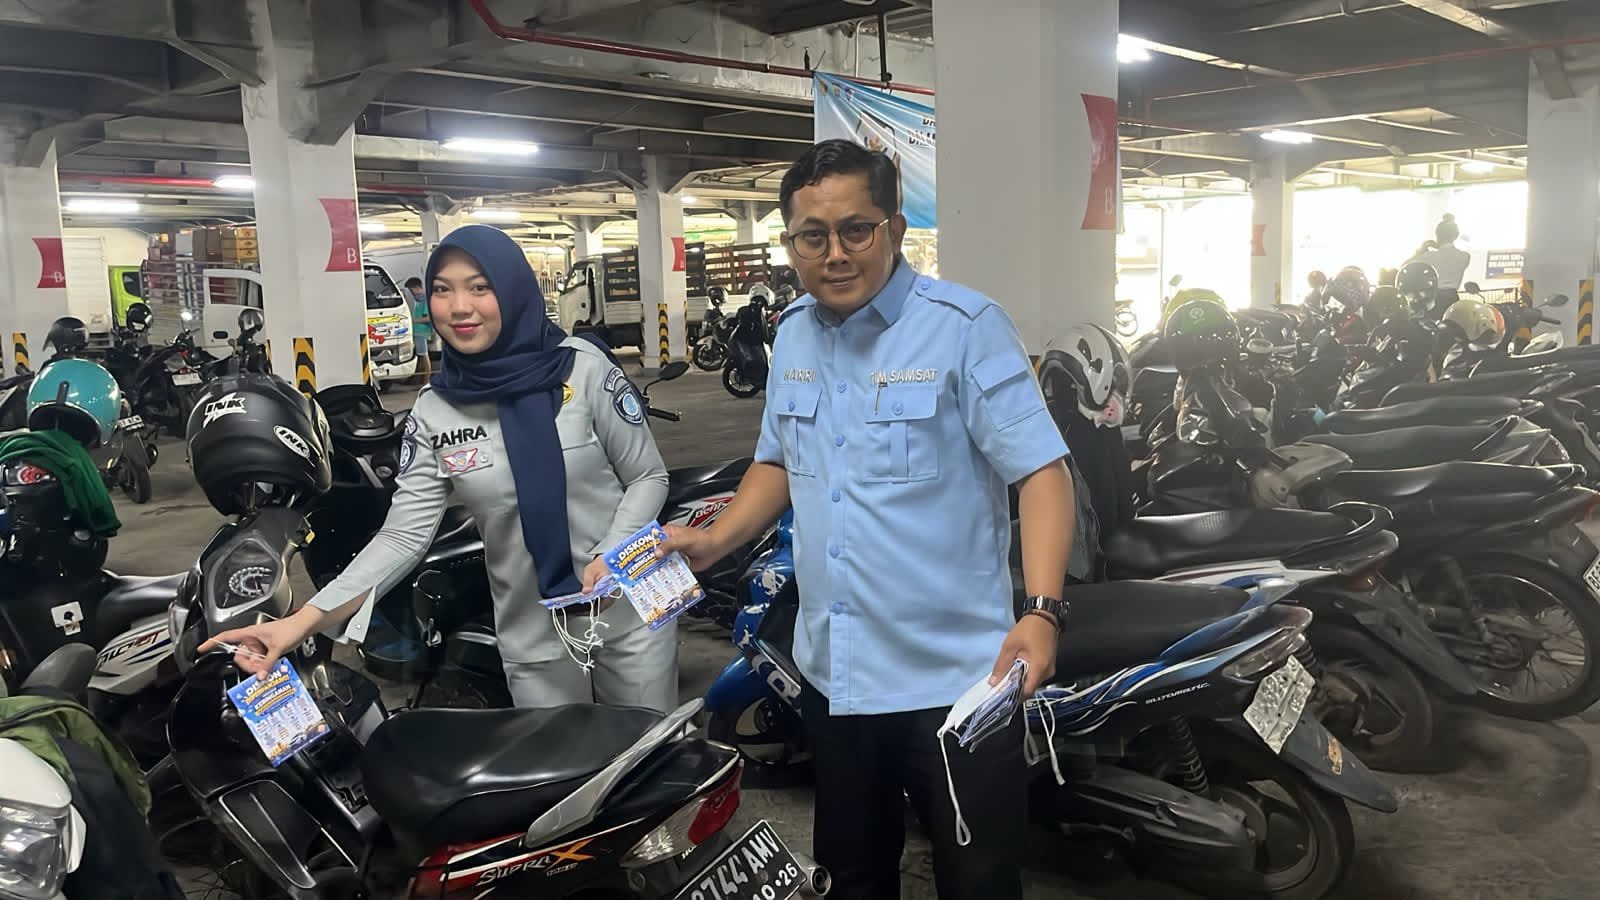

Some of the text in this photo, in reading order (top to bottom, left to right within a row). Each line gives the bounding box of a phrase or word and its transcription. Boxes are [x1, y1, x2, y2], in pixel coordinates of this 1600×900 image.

[347, 247, 357, 264] B
[889, 368, 937, 384] SAMSAT
[206, 400, 242, 414] INK
[279, 429, 307, 453] INK
[430, 425, 488, 450] ZAHRA
[617, 533, 655, 561] DISKON
[245, 669, 283, 698] DISON
[741, 828, 780, 874] AMV
